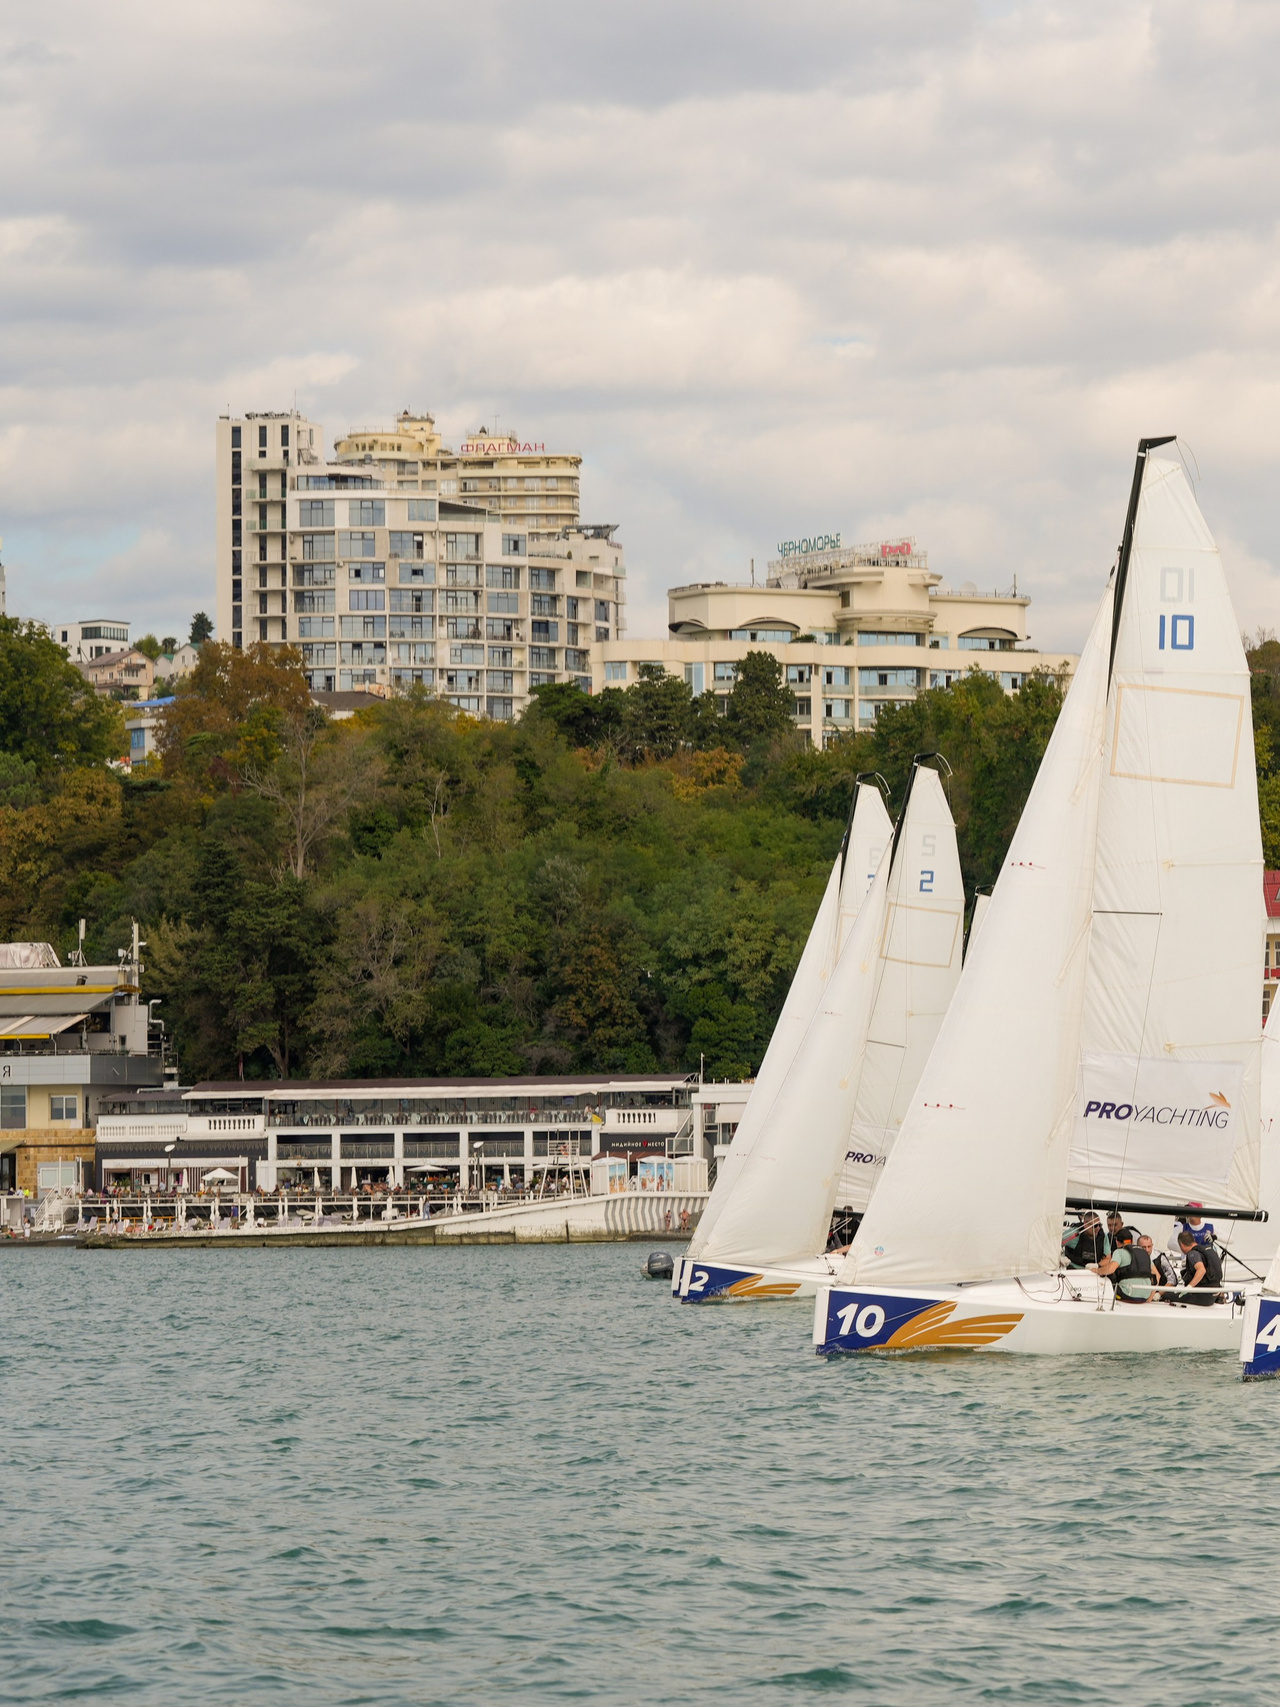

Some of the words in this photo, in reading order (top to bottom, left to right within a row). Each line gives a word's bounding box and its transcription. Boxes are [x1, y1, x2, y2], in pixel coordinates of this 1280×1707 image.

[460, 442, 545, 453] ФЛАГМАН
[777, 532, 841, 557] ЧЕРНОМОРЬЕ
[1159, 614, 1194, 650] 10
[919, 870, 934, 892] 2
[1083, 1100, 1229, 1129] PROYACHTING
[689, 1270, 710, 1292] 2
[836, 1302, 885, 1338] 10
